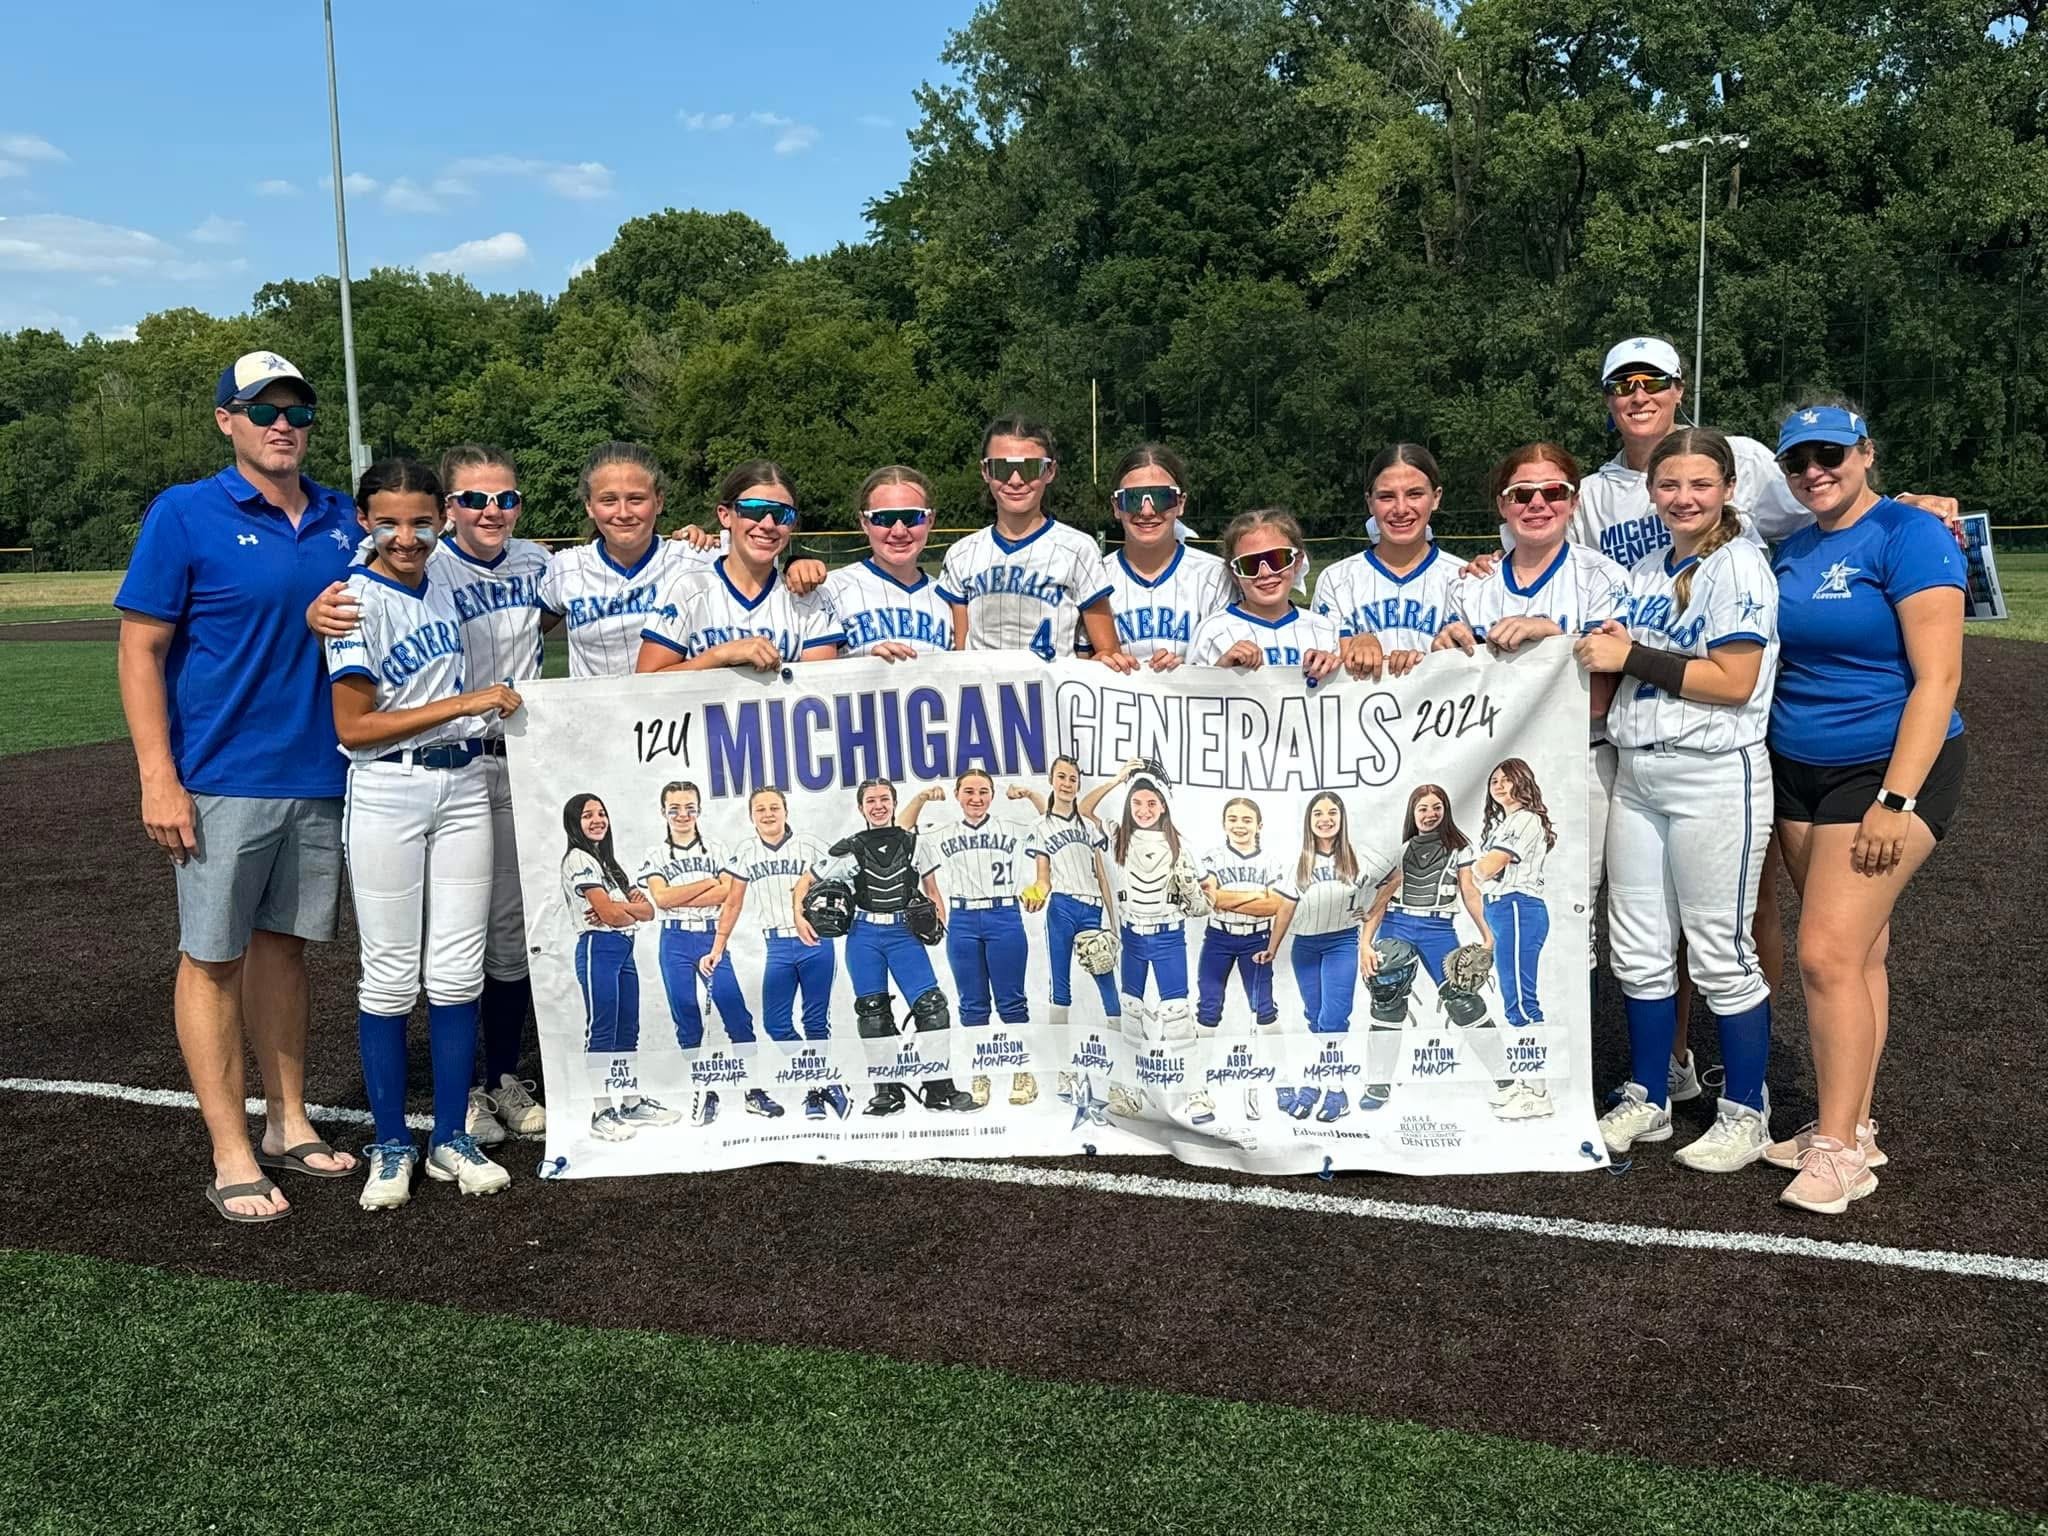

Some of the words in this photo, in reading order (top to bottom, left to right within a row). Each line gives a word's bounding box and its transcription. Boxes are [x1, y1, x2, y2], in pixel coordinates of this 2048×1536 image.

[1601, 514, 1670, 550] MICHI
[633, 711, 691, 768] 12U
[702, 680, 1049, 799] MICHIGAN
[1056, 680, 1402, 792] GENERALS
[1411, 694, 1502, 742] 2024
[940, 832, 1017, 858] GENERALS
[992, 861, 1014, 886] 21
[976, 1041, 1023, 1055] MADISON
[1080, 1041, 1107, 1057] LAURA
[1414, 1048, 1454, 1062] PAYTON
[1506, 1047, 1547, 1060] SYDNEY
[791, 1056, 826, 1070] EMORY
[896, 1051, 921, 1065] KAIA
[972, 1053, 1031, 1069] MONROE
[1071, 1053, 1115, 1076] AUBREY
[1135, 1055, 1185, 1071] ANNABELLE
[1226, 1054, 1253, 1067] ABBY
[1319, 1050, 1344, 1064] ADDI
[611, 1067, 630, 1078] CAT
[692, 1058, 745, 1072] KAEDENCE
[867, 1059, 950, 1078] RICHARDSON
[1303, 1063, 1361, 1081] MASTAKO
[1411, 1061, 1462, 1079] MUNDT
[1509, 1060, 1545, 1074] COOK
[691, 1071, 749, 1086] RYZNAR
[776, 1066, 842, 1083] HUBBELL
[1136, 1068, 1184, 1089] MASTAKO
[1206, 1066, 1276, 1086] BARNOSKY
[605, 1077, 638, 1092] FOKA
[851, 1132, 879, 1140] VARSITY
[919, 1128, 970, 1138] ORTHODONTICS
[1400, 1136, 1462, 1148] DENTISTRY
